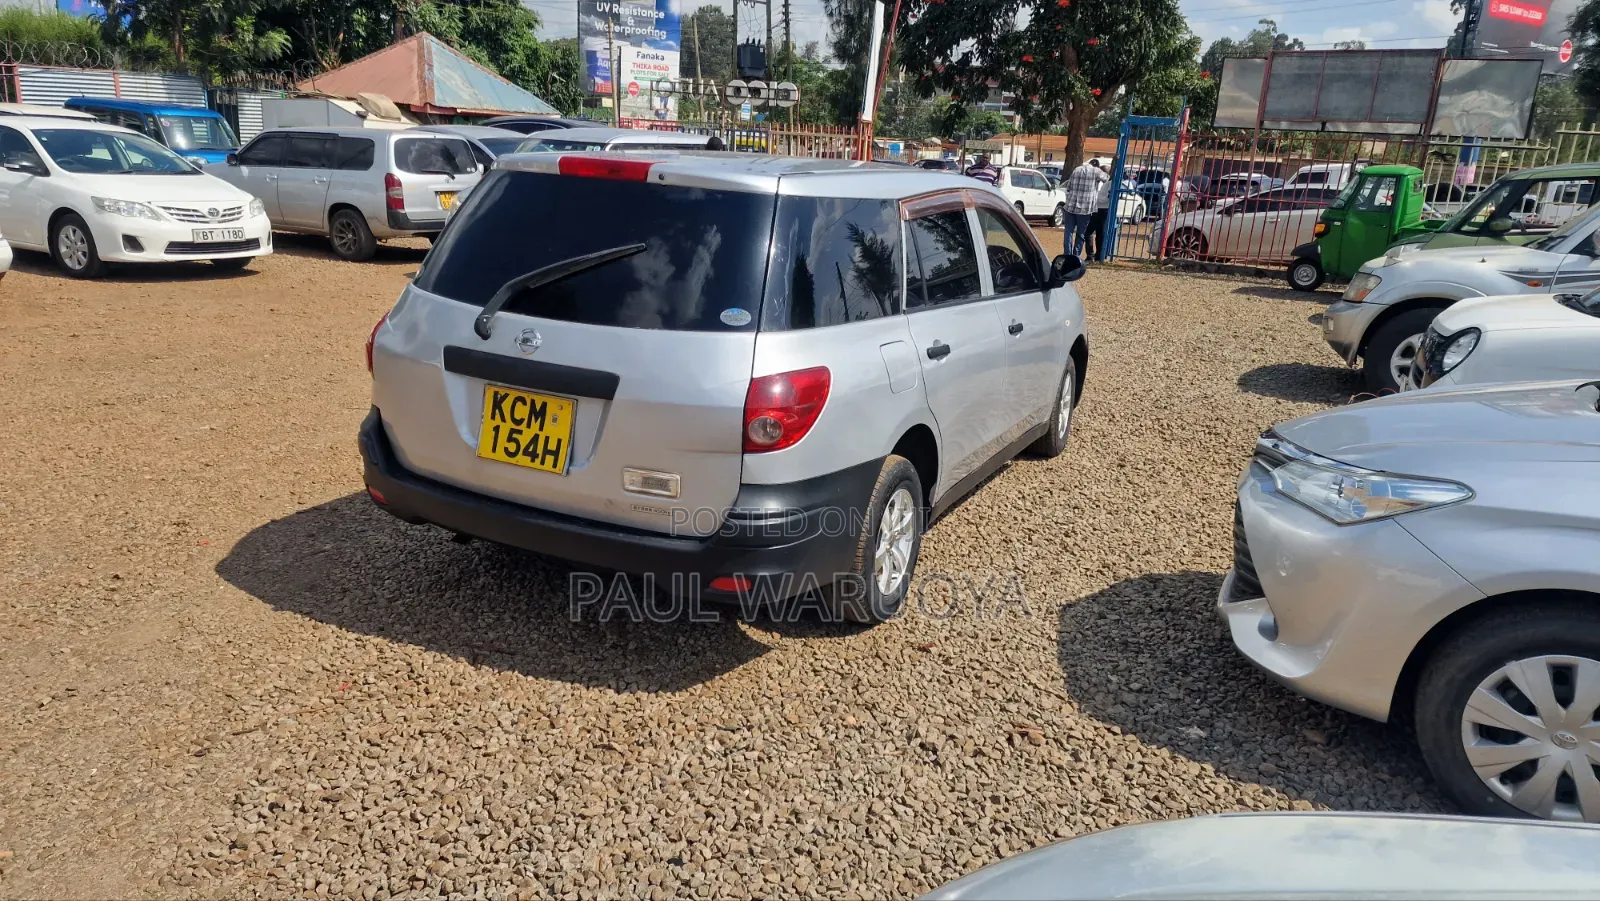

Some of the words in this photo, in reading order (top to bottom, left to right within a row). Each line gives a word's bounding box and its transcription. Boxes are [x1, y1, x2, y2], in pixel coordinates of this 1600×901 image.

[597, 1, 610, 13] UV
[612, 3, 665, 19] Resistance
[627, 16, 635, 27] &
[636, 51, 665, 62] Fanaka
[632, 62, 652, 70] THIKA
[652, 64, 670, 72] ROAD
[221, 229, 244, 240] 118D
[490, 390, 548, 432] KCM
[491, 424, 562, 469] 154H
